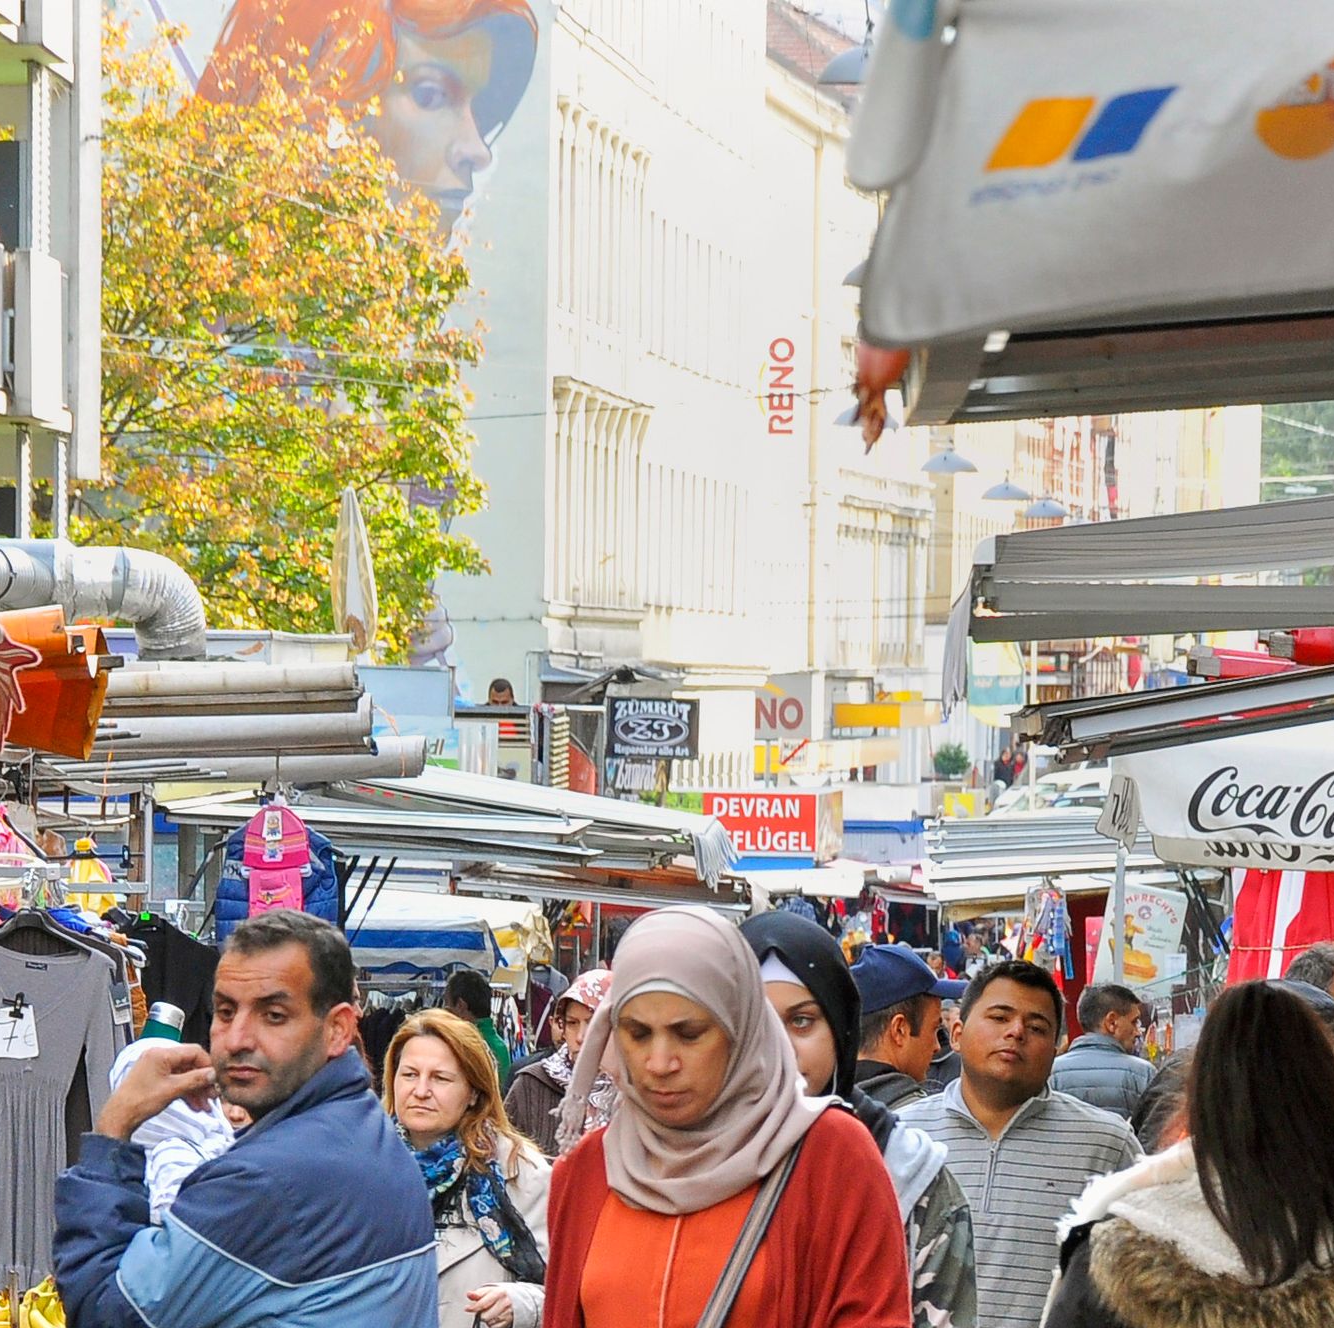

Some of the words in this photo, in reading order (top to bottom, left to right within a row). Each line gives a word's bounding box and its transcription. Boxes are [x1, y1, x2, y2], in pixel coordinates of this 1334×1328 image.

[768, 337, 795, 434] RENO
[614, 698, 691, 723] ZÜMRÜT
[712, 796, 800, 819] DEVRAN
[726, 826, 812, 852] FLÜGEL
